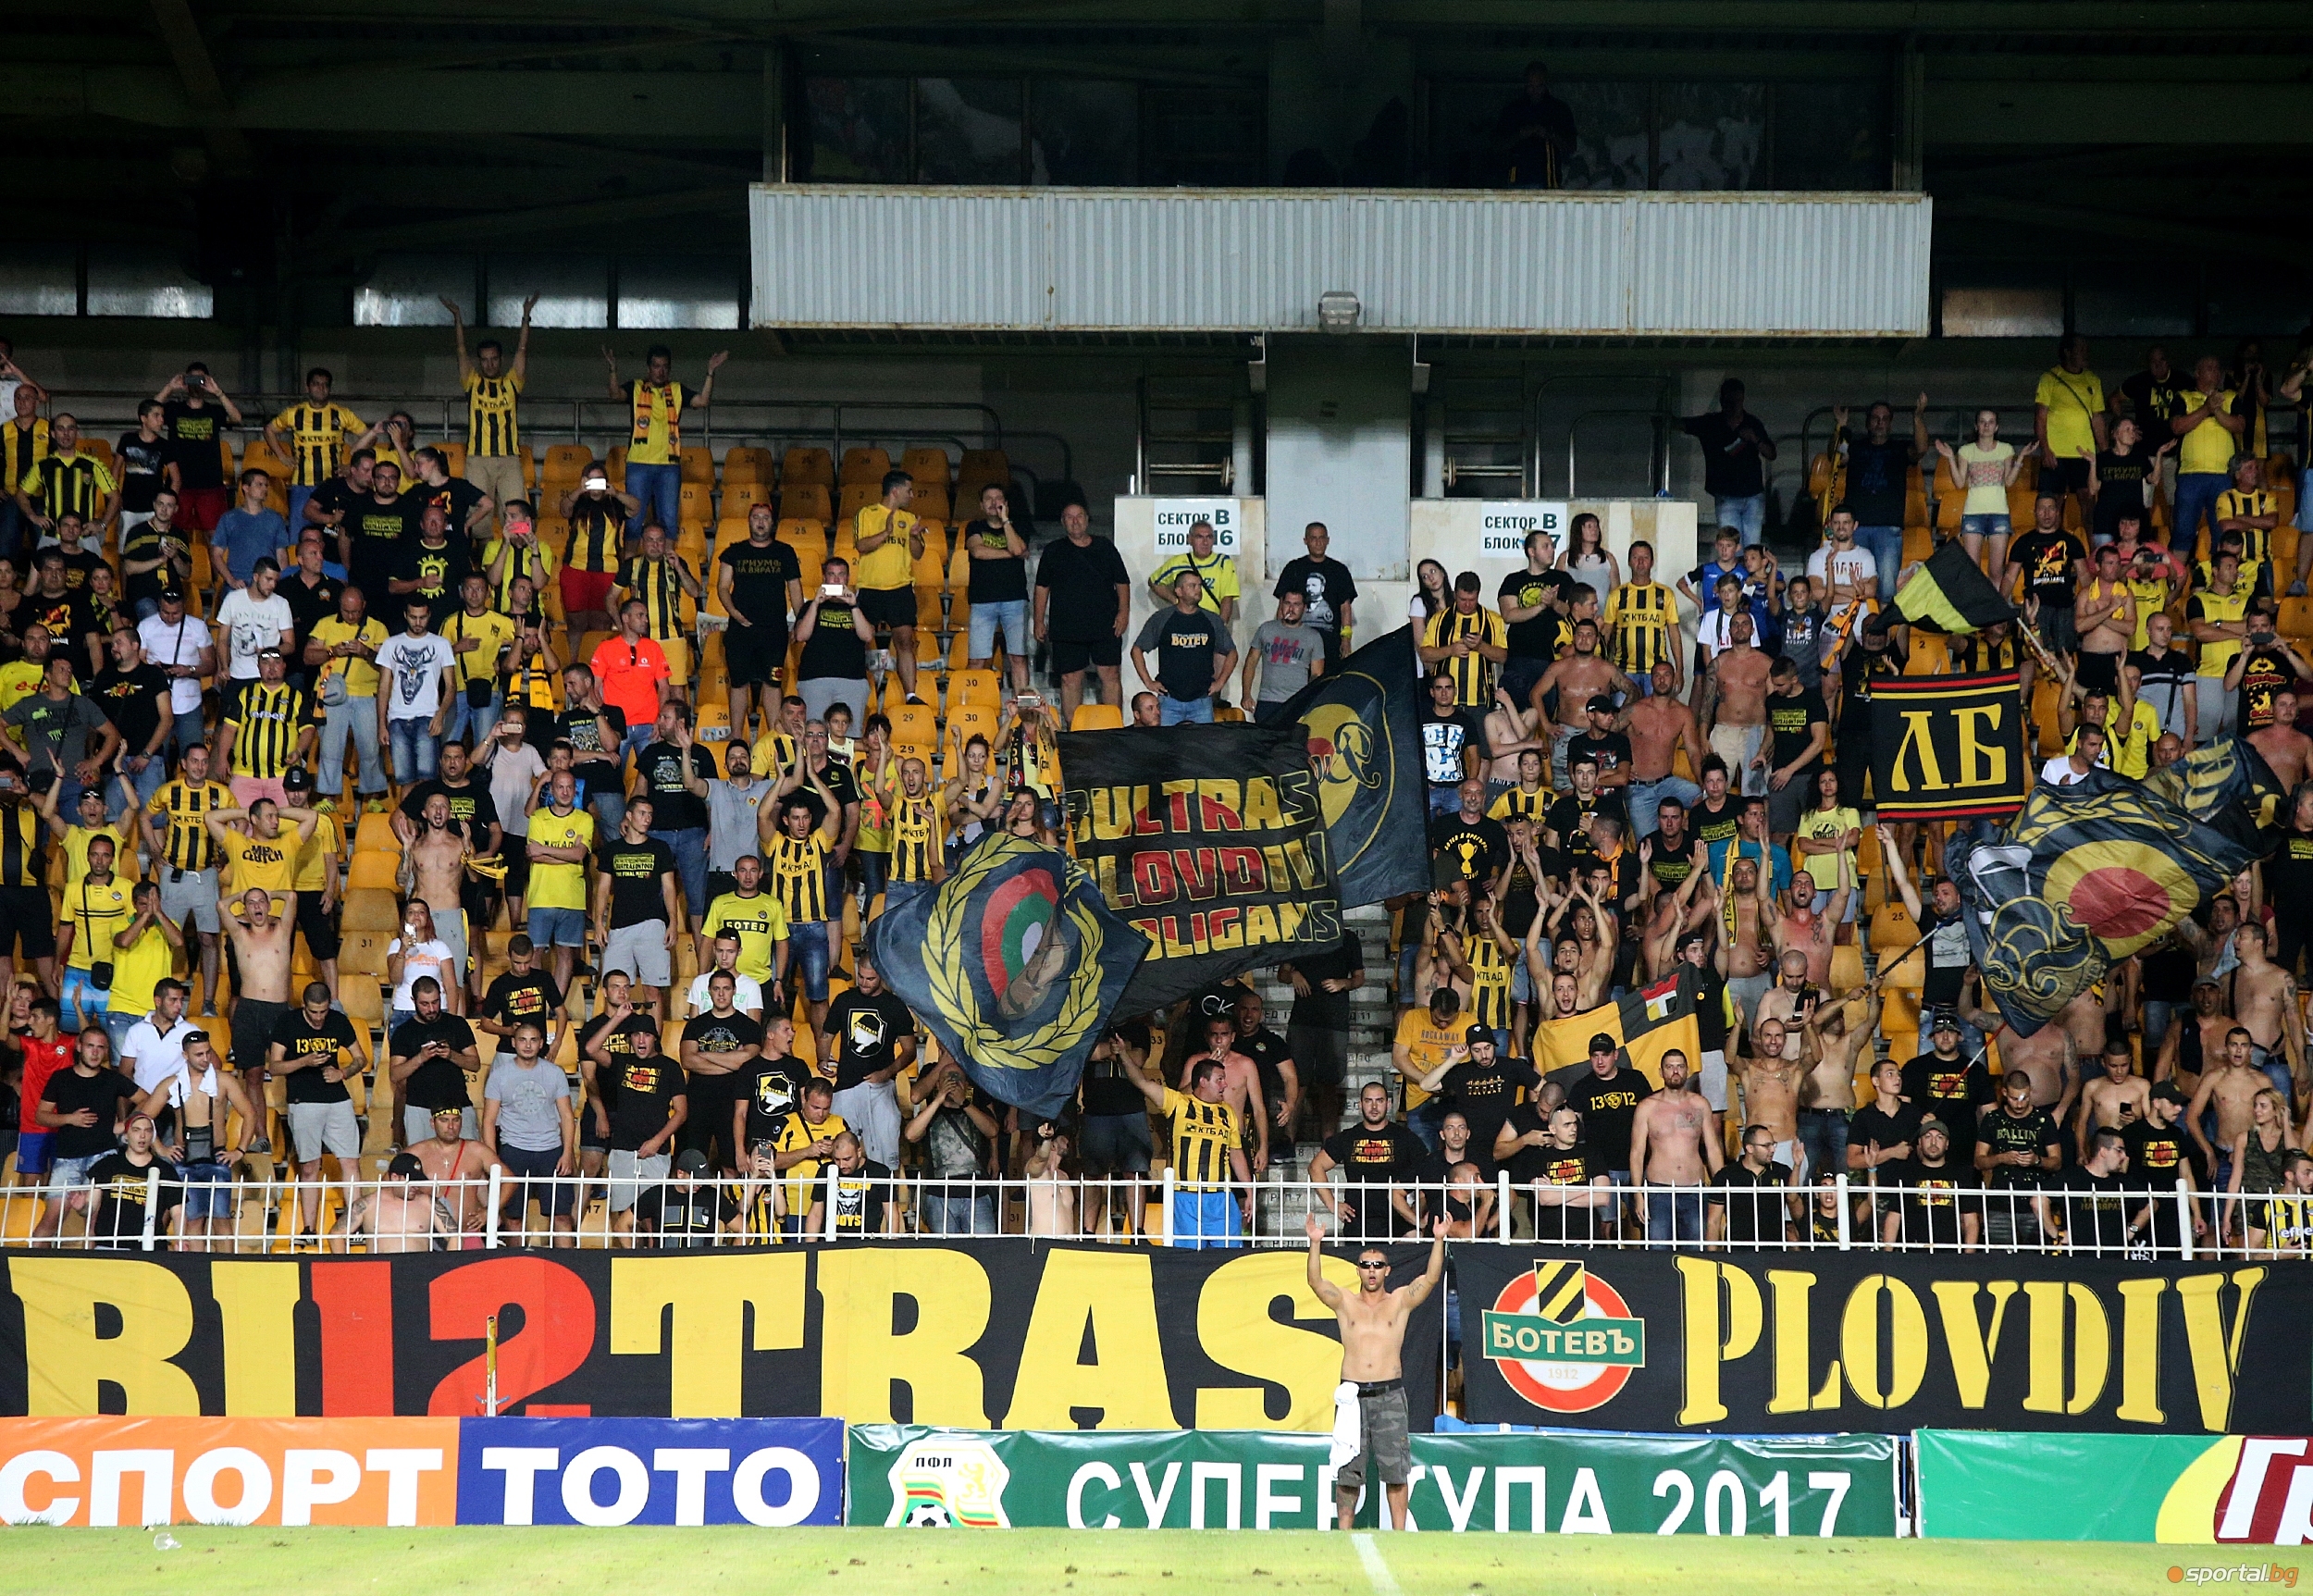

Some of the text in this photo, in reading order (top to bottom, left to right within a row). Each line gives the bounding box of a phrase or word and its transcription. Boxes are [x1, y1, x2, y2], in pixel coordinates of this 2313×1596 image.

[1157, 508, 1231, 526] СЕКТОР В
[1484, 513, 1558, 530] СЕКТОР В
[1157, 532, 1192, 547] БЛО
[1484, 536, 1520, 551] БЛОК
[1631, 613, 1660, 624] КТБ АД
[1786, 627, 1812, 640] LIFE
[1170, 636, 1209, 647] BOTEV
[966, 678, 978, 687] 30
[717, 711, 728, 721] 26
[902, 712, 914, 723] 29
[965, 712, 978, 722] 30
[900, 744, 915, 754] 29
[1892, 911, 1904, 922] 25
[1127, 899, 1342, 961] OLIGANS
[1476, 970, 1503, 983] КТБ АД
[1150, 1035, 1163, 1045] 33
[1420, 1029, 1460, 1042] ROCKAWAY
[295, 1037, 309, 1054] 13
[1589, 1092, 1638, 1111] 13 12
[1197, 1124, 1229, 1141] КТБ АД
[1492, 1321, 1635, 1355] БОТЕВЪ
[1673, 1255, 2270, 1433] PLOVDIV
[1547, 1367, 1579, 1380] 1912
[915, 1456, 953, 1468] ПФЛ
[0, 1446, 443, 1528] СПОРТ
[481, 1445, 821, 1528] ТОТО
[1651, 1468, 1852, 1538] 2017
